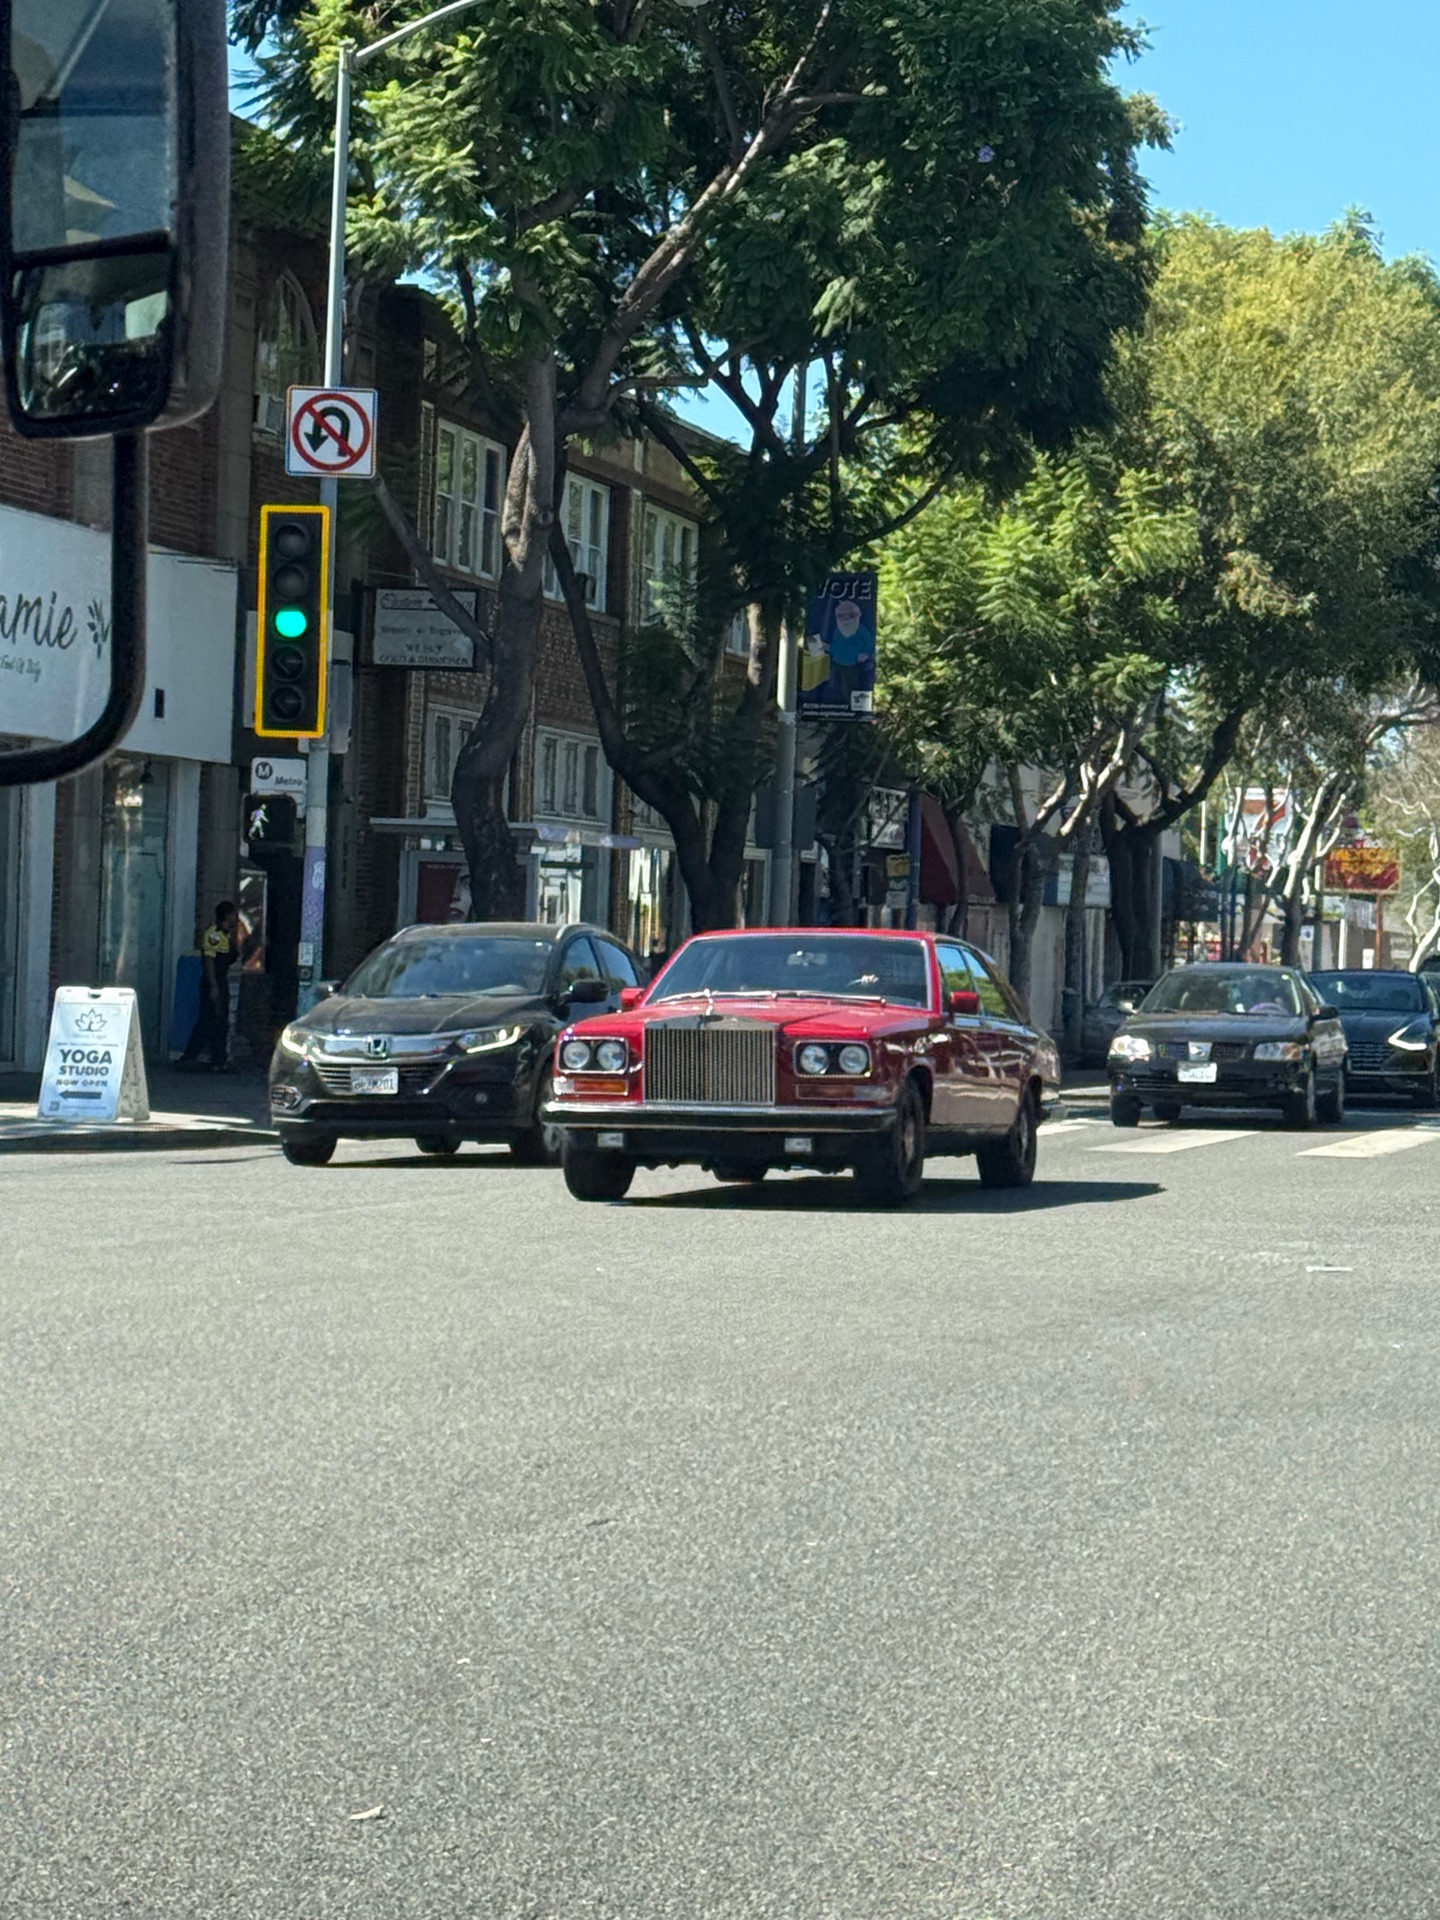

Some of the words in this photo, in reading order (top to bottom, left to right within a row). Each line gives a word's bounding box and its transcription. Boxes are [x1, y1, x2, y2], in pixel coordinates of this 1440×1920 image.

[815, 578, 872, 600] VOTE
[274, 776, 303, 786] Metro
[59, 1049, 113, 1065] YOGA
[58, 1065, 109, 1077] STUDIO
[56, 1079, 79, 1087] NOW
[81, 1079, 109, 1088] OPEN
